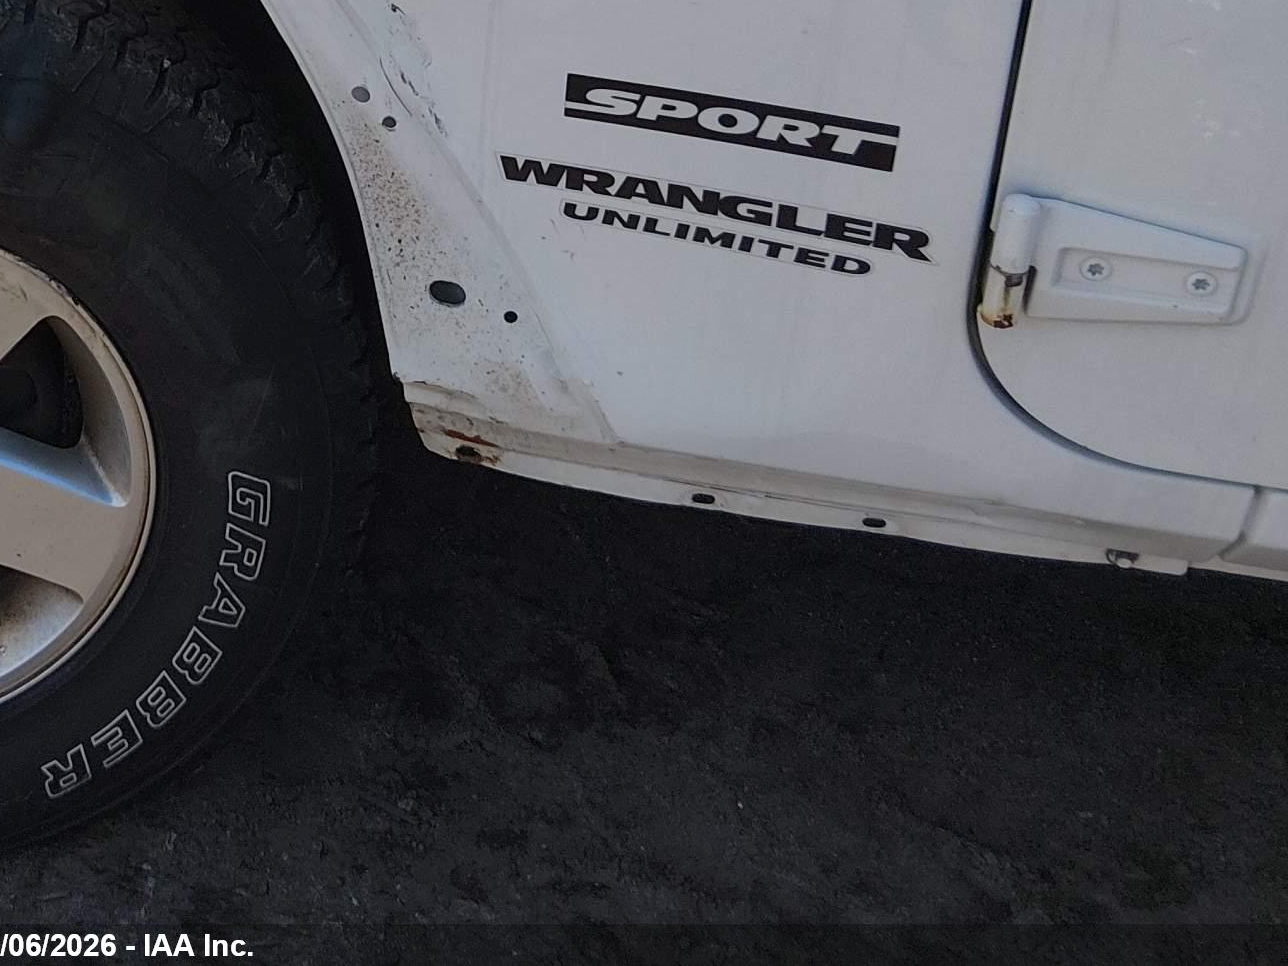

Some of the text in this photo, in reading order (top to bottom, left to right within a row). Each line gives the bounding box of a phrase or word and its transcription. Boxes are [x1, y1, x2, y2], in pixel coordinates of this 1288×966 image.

[581, 86, 873, 157] SPORT
[499, 154, 934, 263] WRANGLER
[562, 201, 871, 275] UNLIMITED
[40, 470, 271, 798] GRABBER
